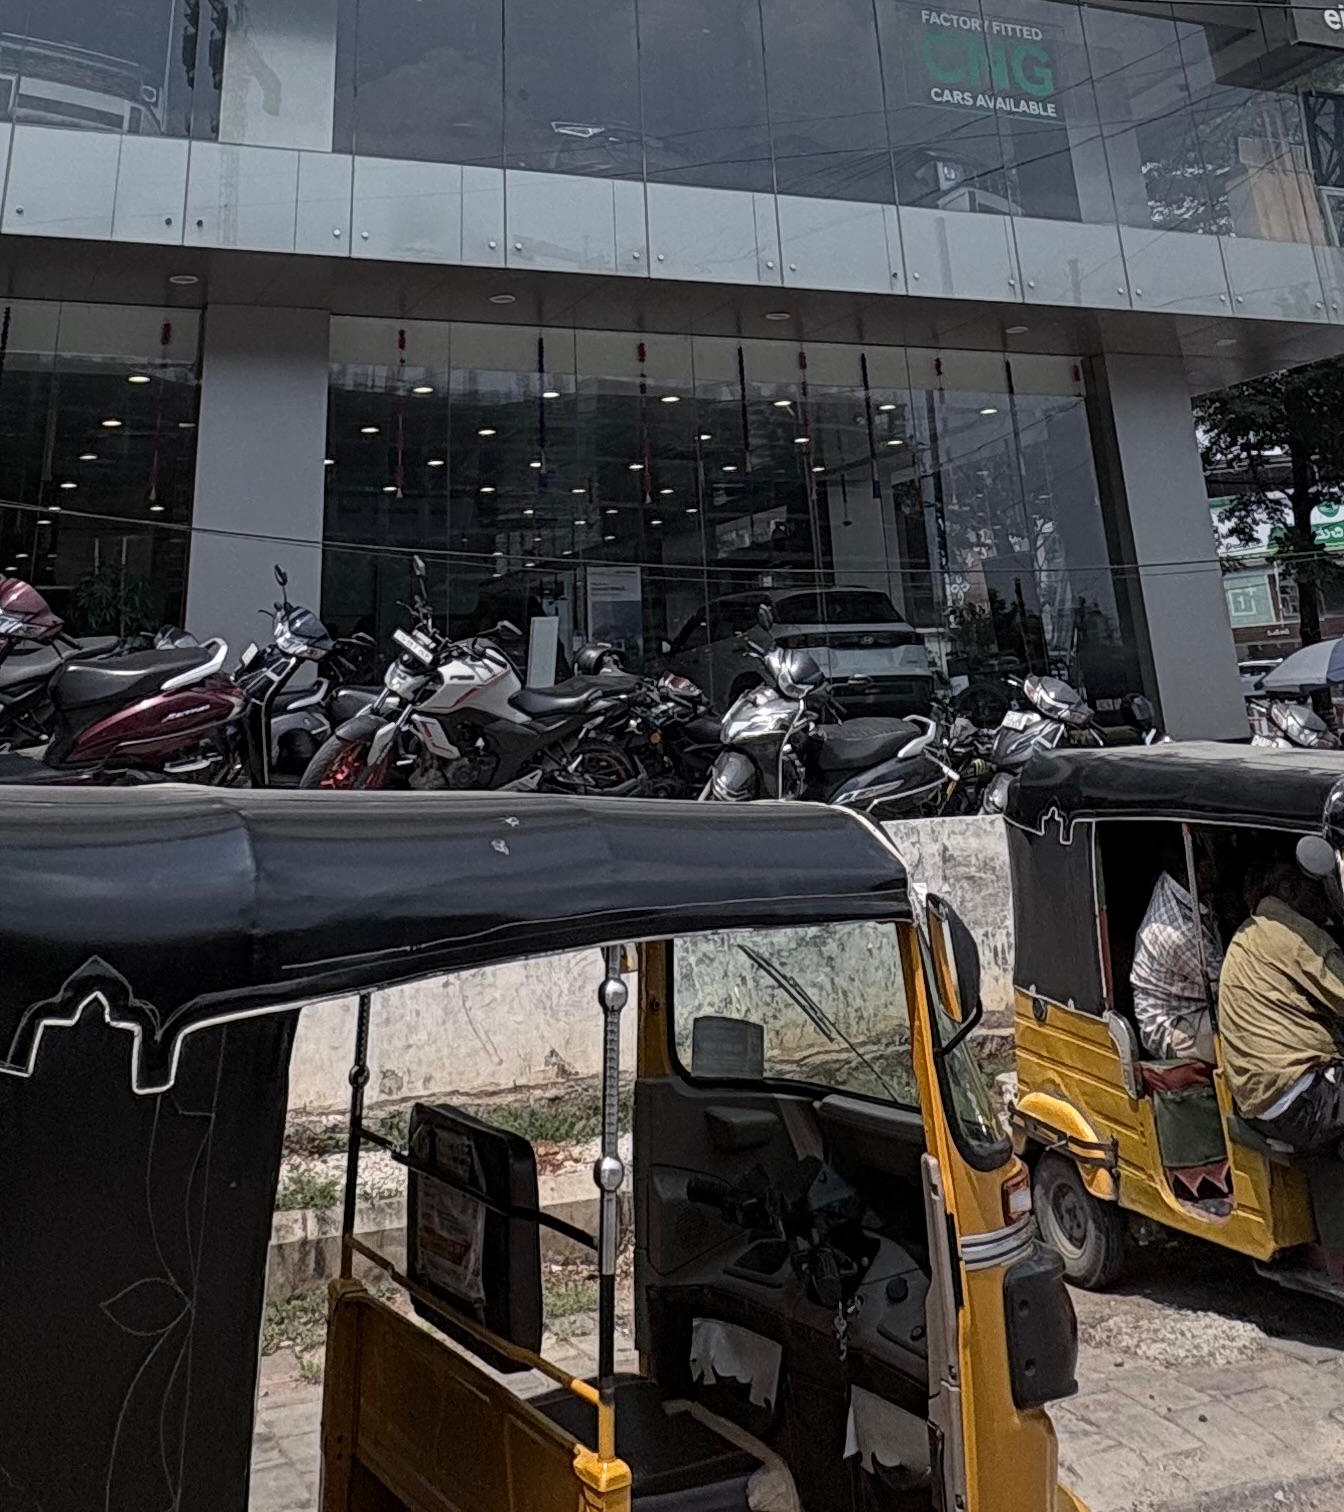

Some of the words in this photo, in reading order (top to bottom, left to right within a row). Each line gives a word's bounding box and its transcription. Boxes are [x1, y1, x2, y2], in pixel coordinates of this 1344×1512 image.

[992, 21, 1043, 41] FITTED
[922, 29, 1056, 97] CNG
[930, 87, 974, 106] CARS
[975, 94, 1058, 117] AVAILABLE
